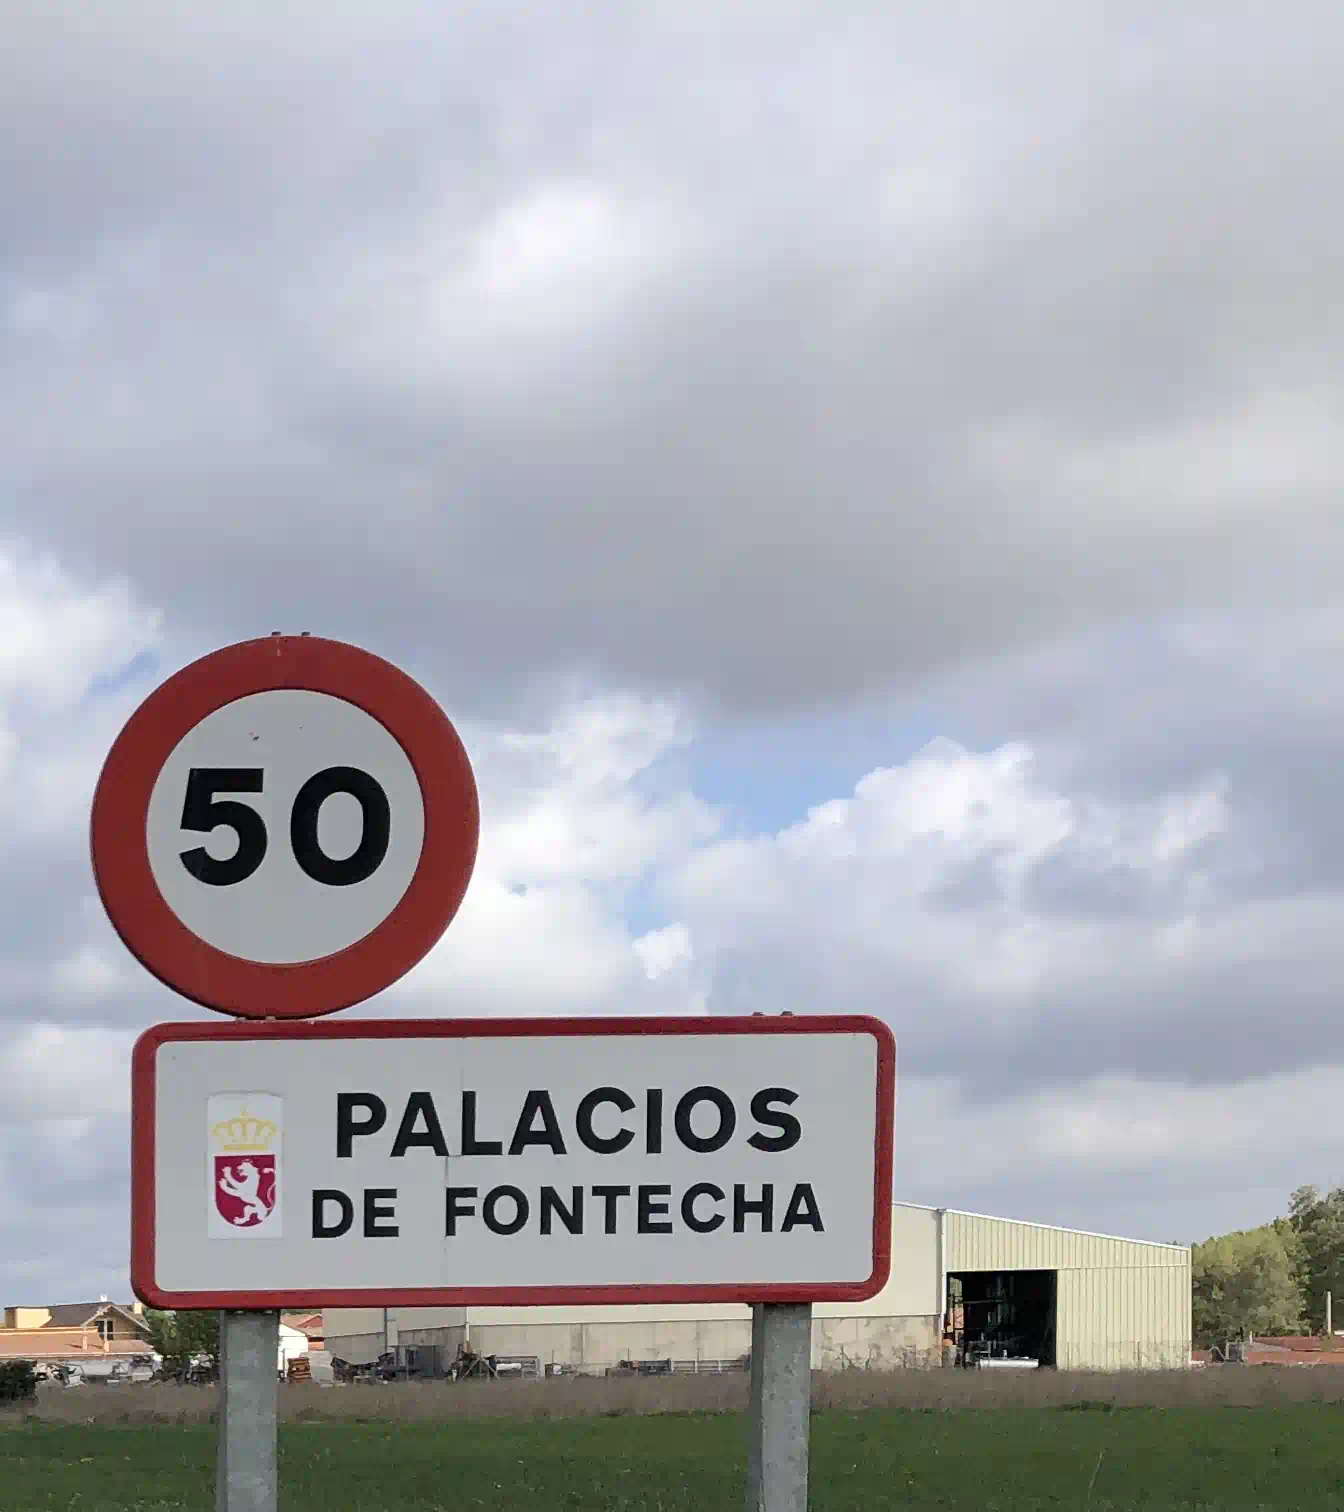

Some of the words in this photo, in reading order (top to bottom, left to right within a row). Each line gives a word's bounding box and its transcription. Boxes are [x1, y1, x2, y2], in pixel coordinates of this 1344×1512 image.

[179, 766, 391, 887] 50
[336, 1086, 802, 1158] PALACIOS
[313, 1187, 400, 1238] DE
[446, 1183, 824, 1236] FONTECHA
